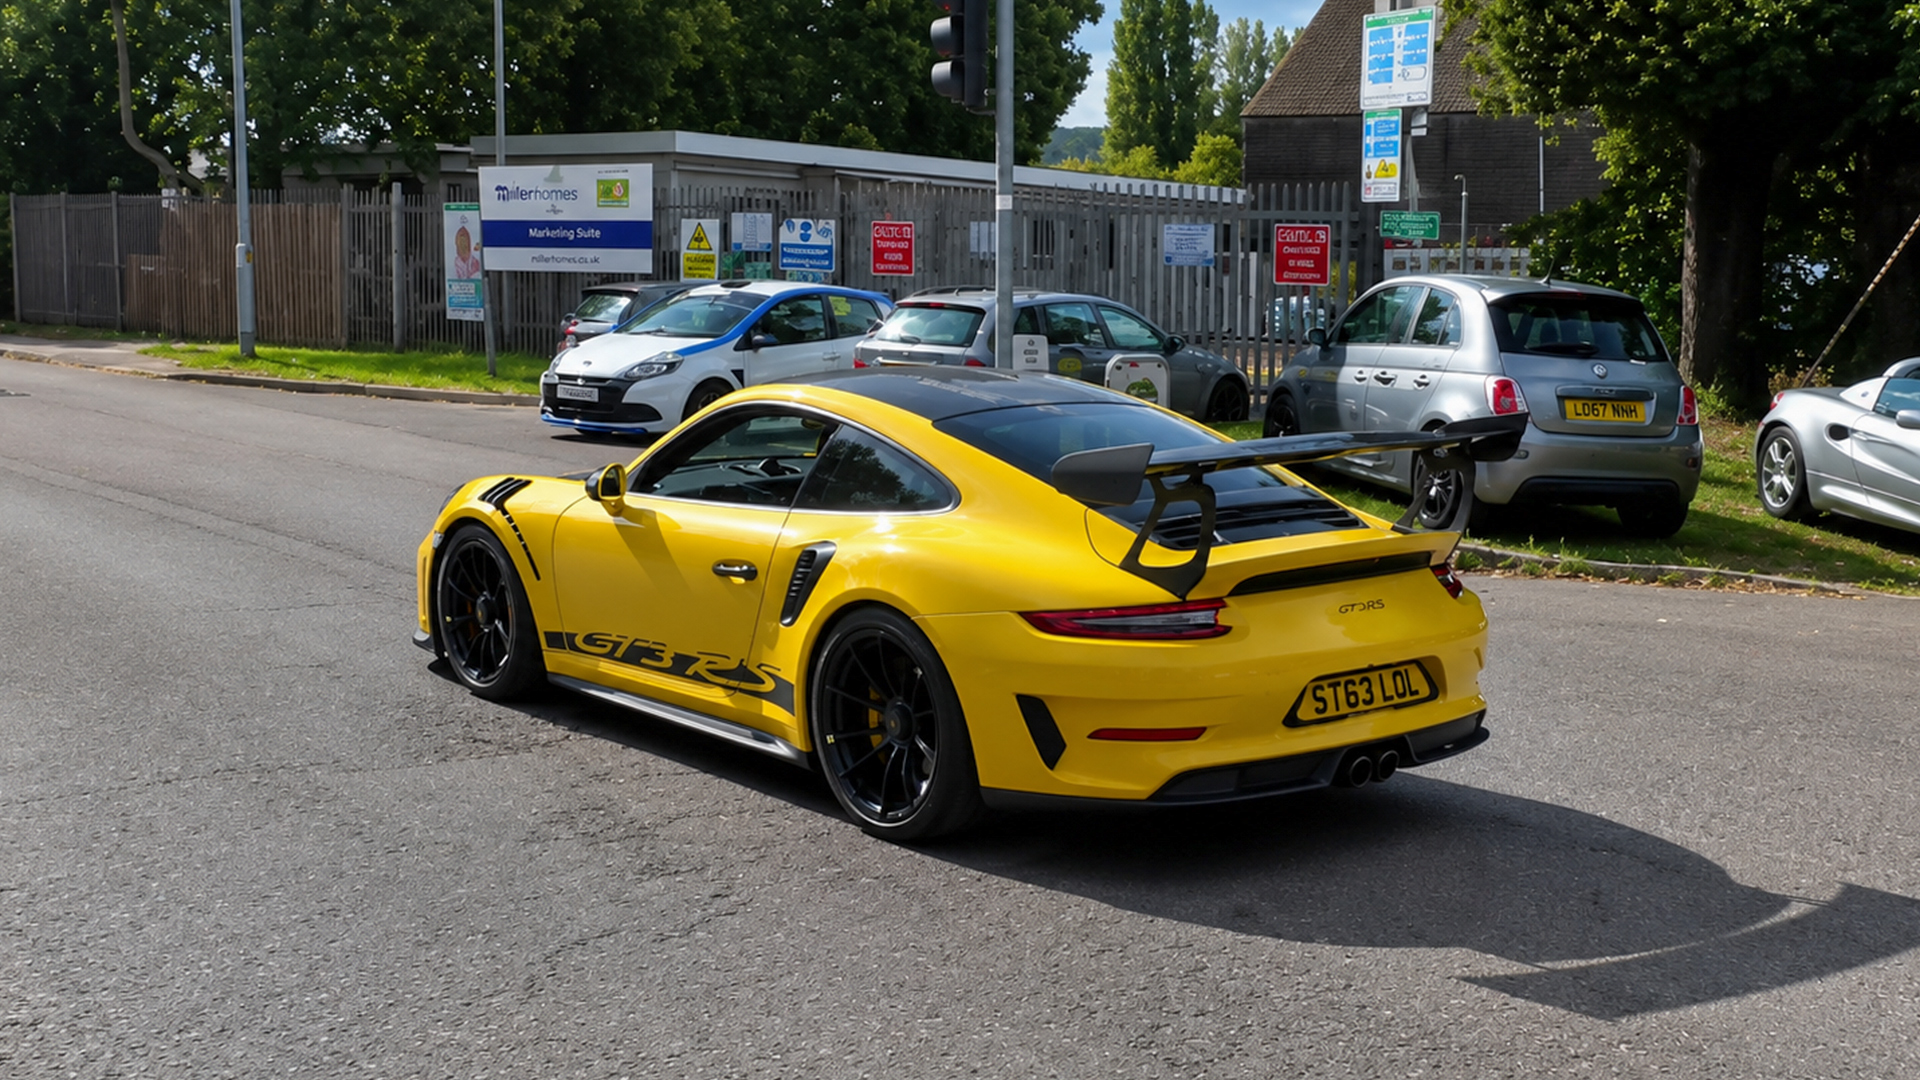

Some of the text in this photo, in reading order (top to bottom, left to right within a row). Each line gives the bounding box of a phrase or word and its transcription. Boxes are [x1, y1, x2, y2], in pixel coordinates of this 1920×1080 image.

[529, 226, 601, 240] Marketing Suite
[1611, 403, 1639, 419] NNH
[574, 632, 781, 693] GT3 RS
[1312, 668, 1420, 715] ST63 LOL
